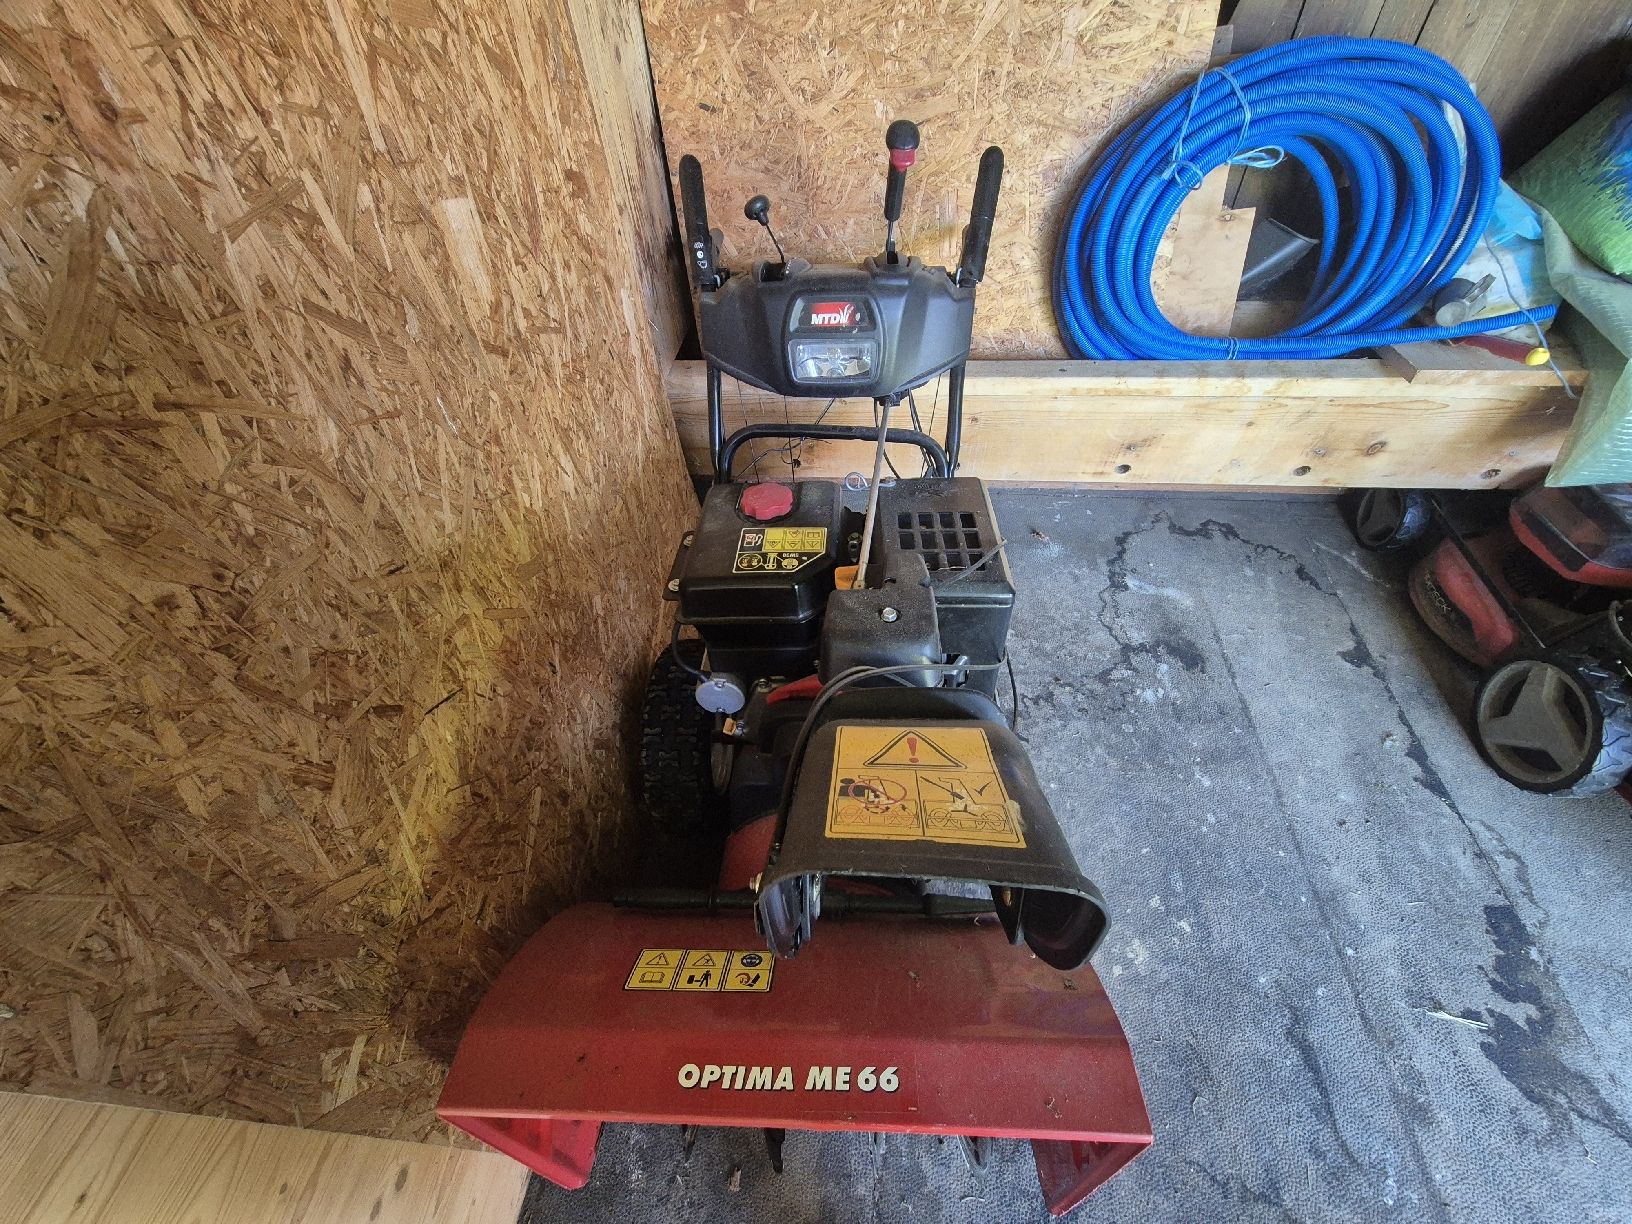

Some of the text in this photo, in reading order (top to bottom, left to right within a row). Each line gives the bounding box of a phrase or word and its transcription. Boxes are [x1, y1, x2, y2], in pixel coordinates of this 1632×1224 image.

[811, 313, 840, 325] MTD
[678, 1063, 899, 1092] OPTIMA ME 66
